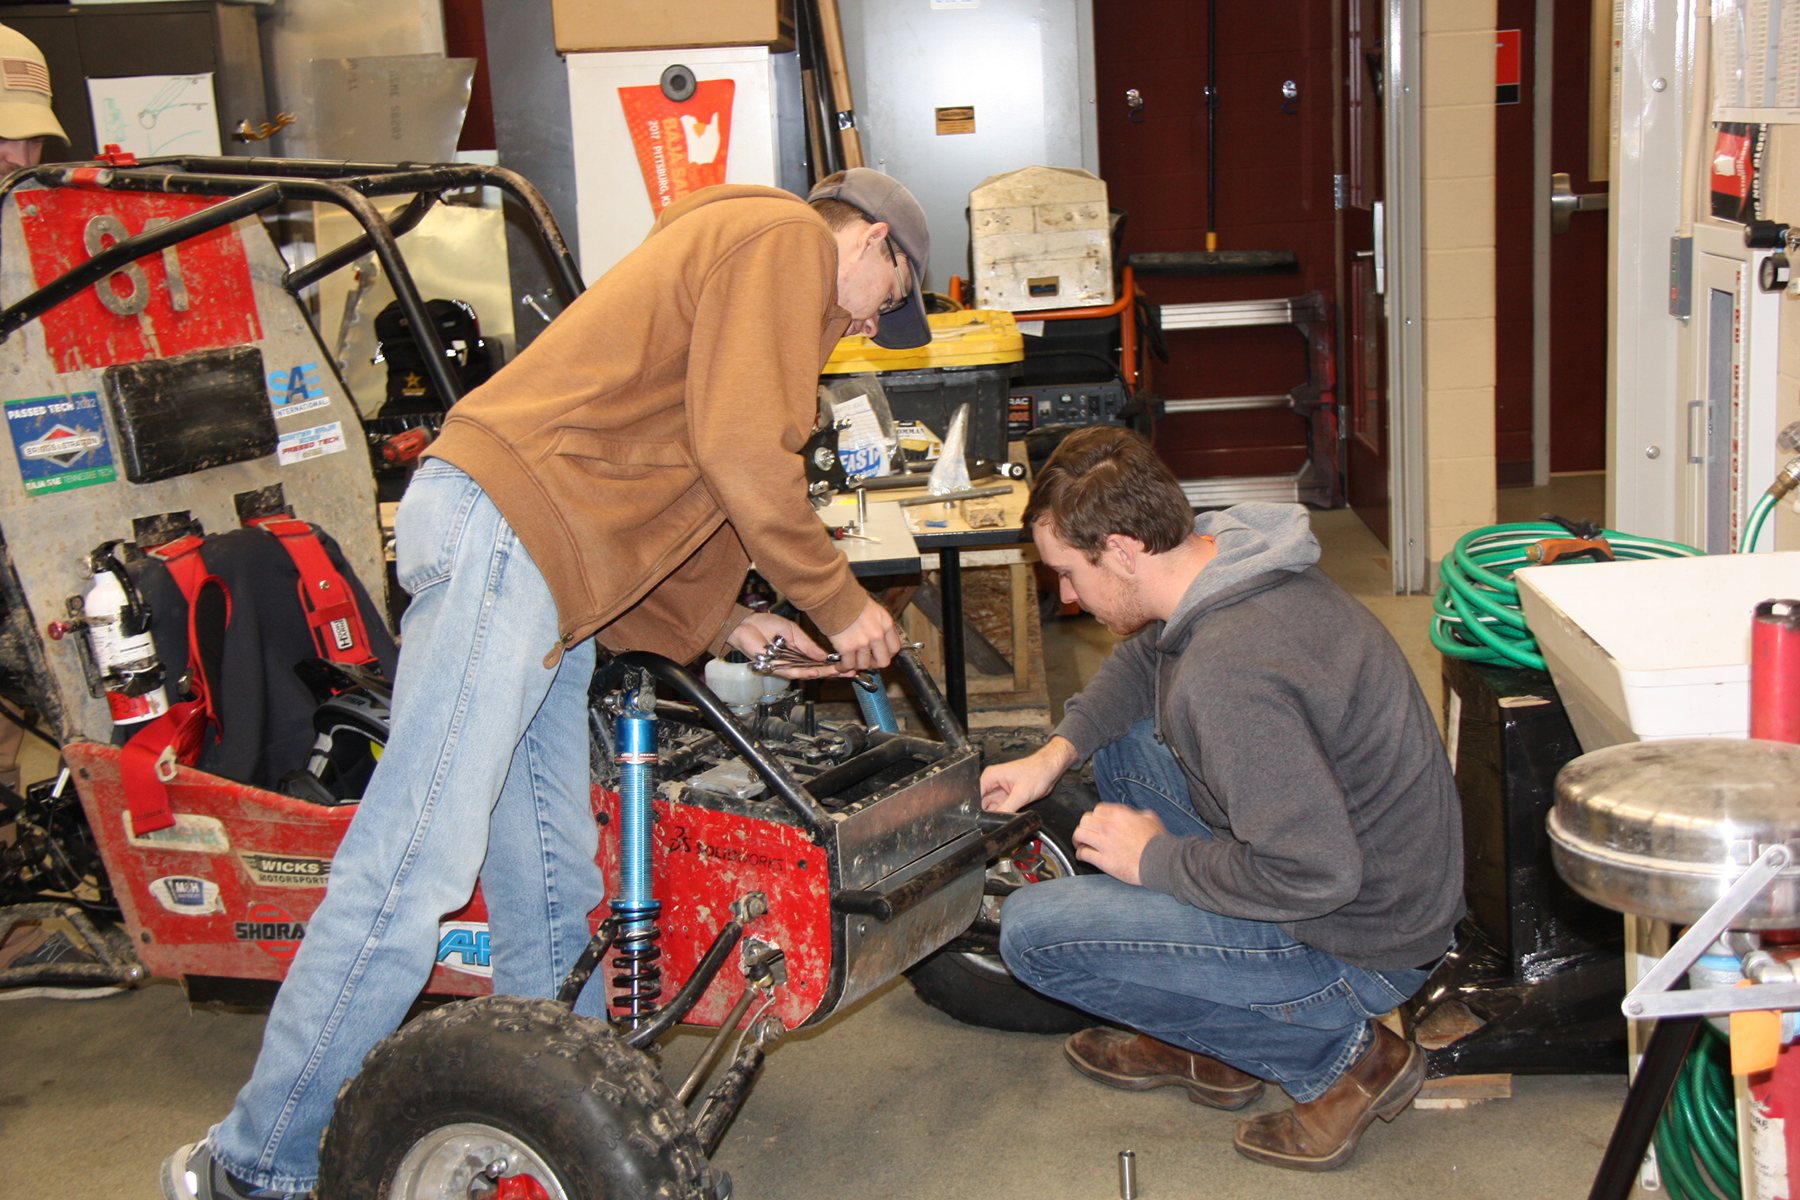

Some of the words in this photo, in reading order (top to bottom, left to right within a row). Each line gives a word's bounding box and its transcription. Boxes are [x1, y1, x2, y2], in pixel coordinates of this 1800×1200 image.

[648, 119, 661, 140] 2017
[662, 117, 684, 165] BAJA
[653, 145, 670, 195] PITTSBURG,
[660, 194, 672, 207] KS
[84, 214, 190, 316] 81
[267, 361, 325, 406] SAE
[7, 405, 48, 420] PASSED
[47, 403, 75, 414] TECH
[317, 436, 340, 447] TECH
[261, 860, 320, 874] WICKS
[696, 842, 784, 871] SOLIDWORKS
